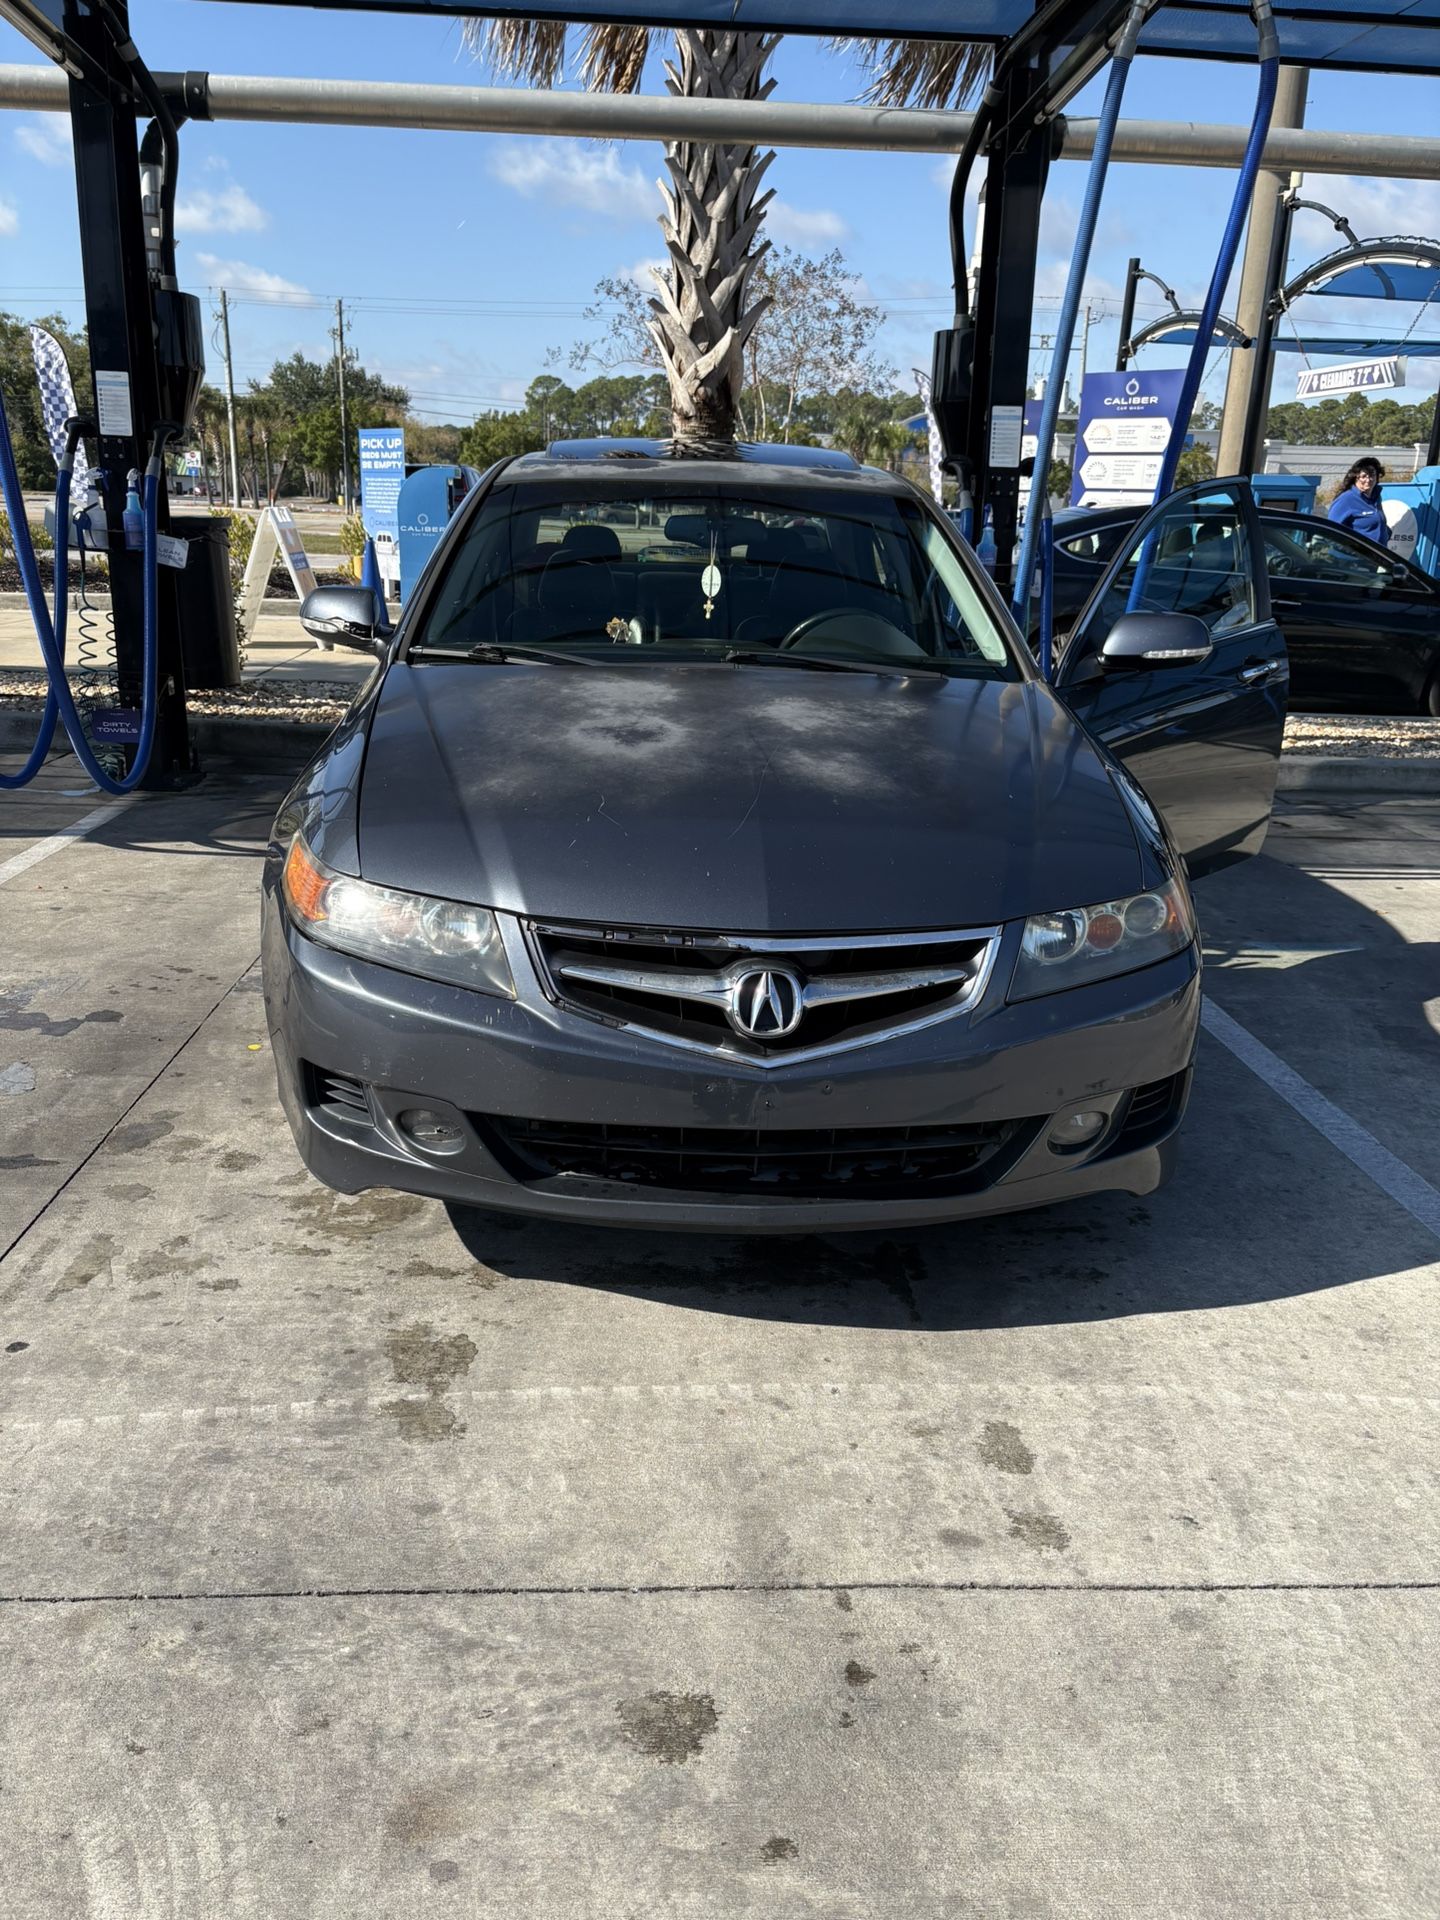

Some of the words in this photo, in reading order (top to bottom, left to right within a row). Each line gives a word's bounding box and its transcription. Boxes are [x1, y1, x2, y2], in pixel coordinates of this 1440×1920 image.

[1320, 369, 1356, 390] CLEARANCE
[1104, 396, 1158, 405] CALIBER
[361, 438, 384, 448] PICK
[386, 438, 402, 448] UP
[361, 451, 380, 459] BEDS
[380, 451, 402, 459] MUST
[361, 461, 373, 469] BE
[373, 461, 402, 469] EMPTY
